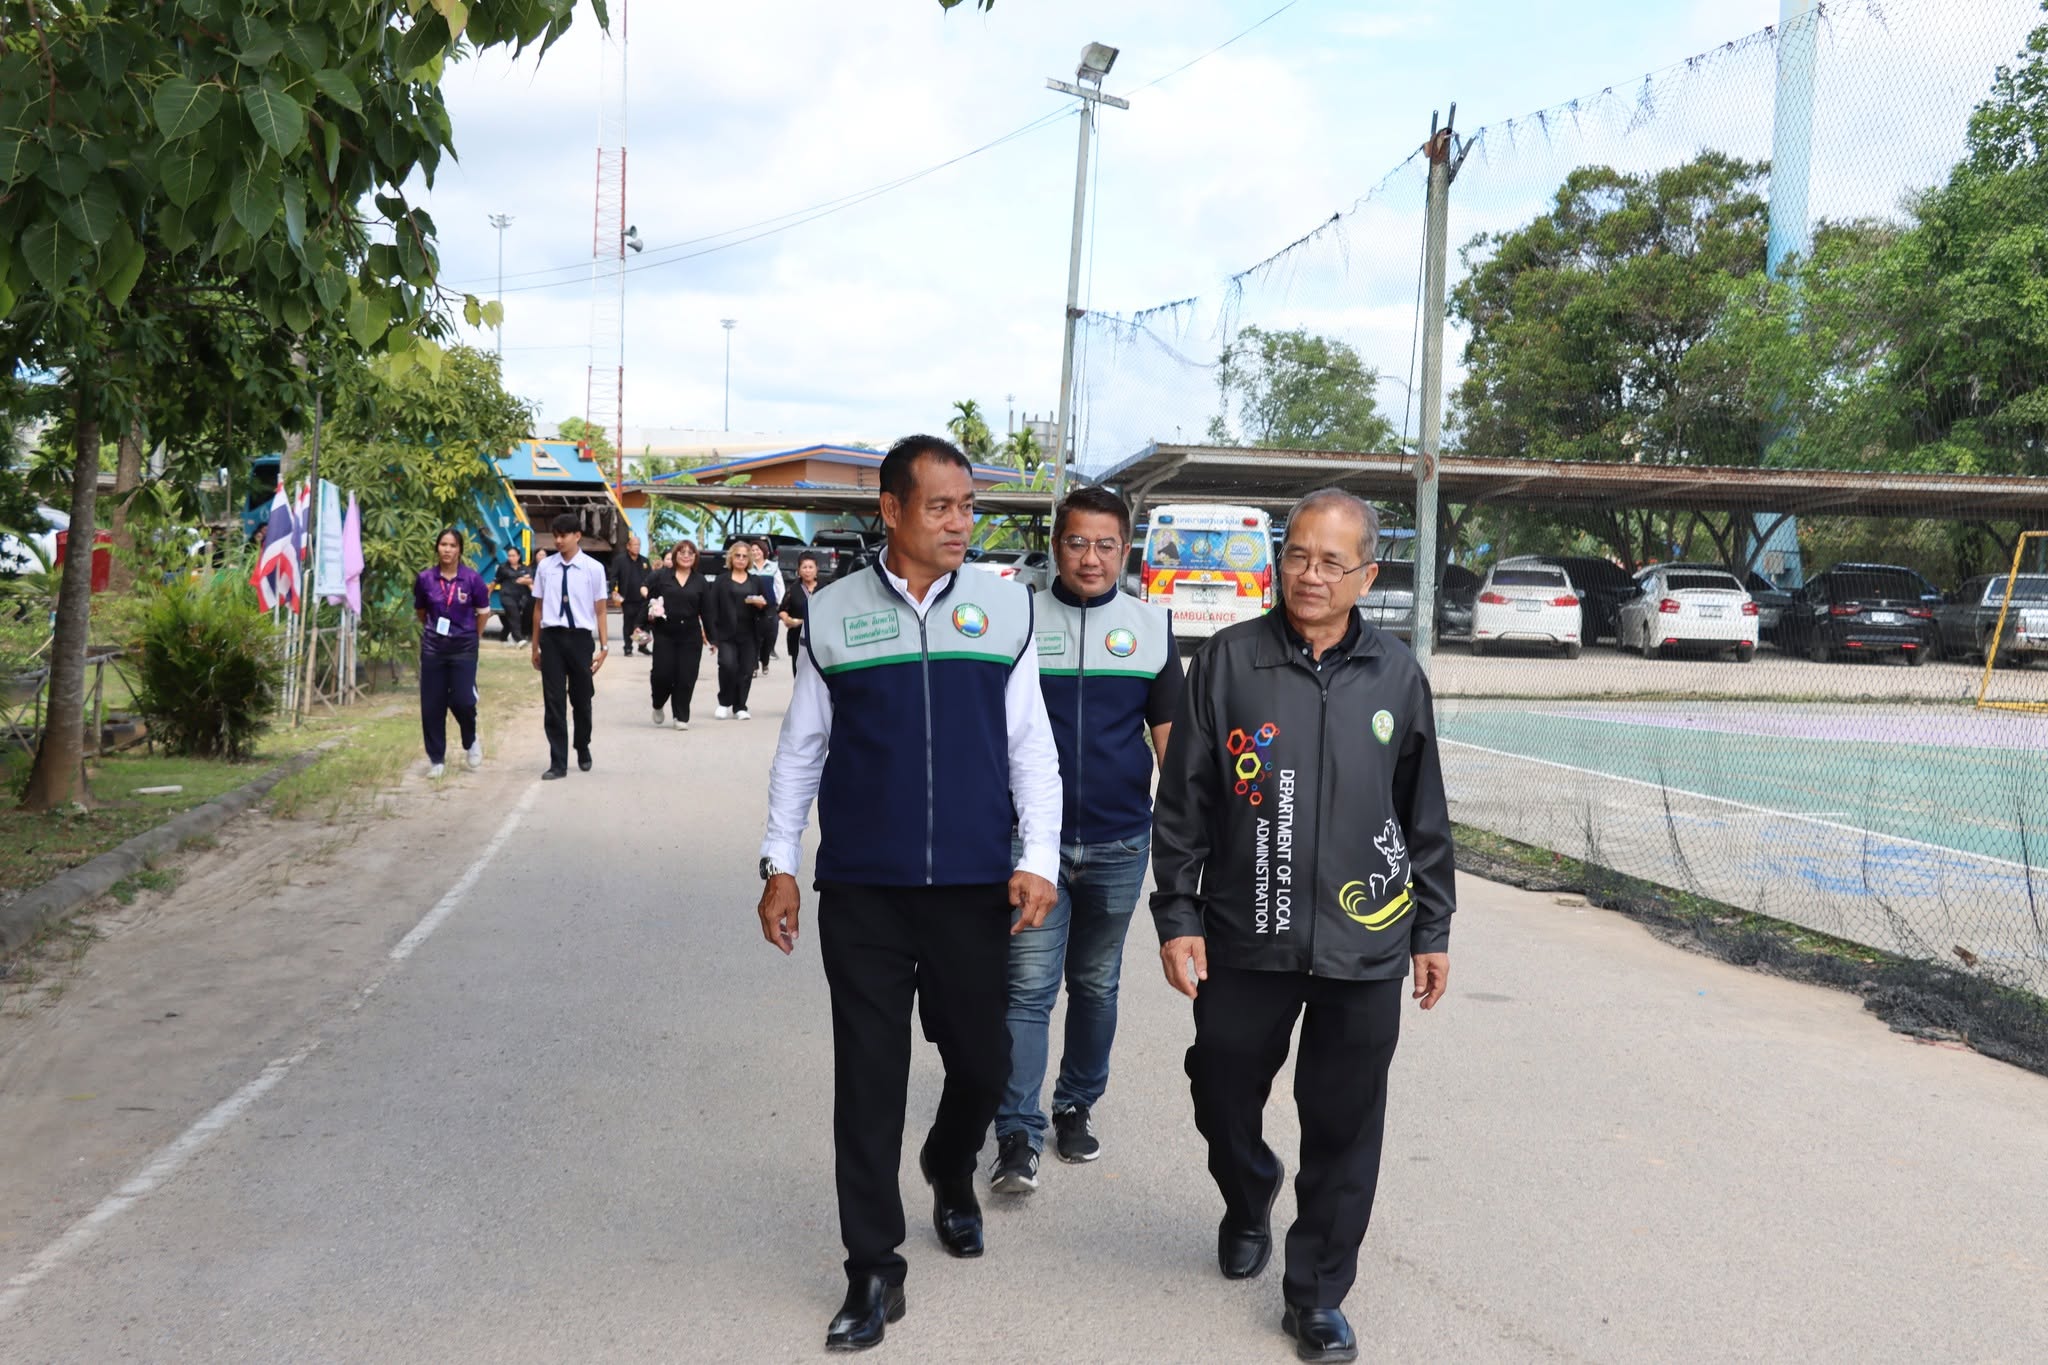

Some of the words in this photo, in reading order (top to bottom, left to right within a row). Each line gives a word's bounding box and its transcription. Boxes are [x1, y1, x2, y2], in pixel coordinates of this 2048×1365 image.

[1173, 611, 1238, 622] AMBULANCE
[1277, 769, 1296, 861] DEPARTMENT
[1256, 817, 1270, 934] ADMINISTRATION
[1276, 864, 1292, 885] OF
[1276, 888, 1292, 935] LOCAL
